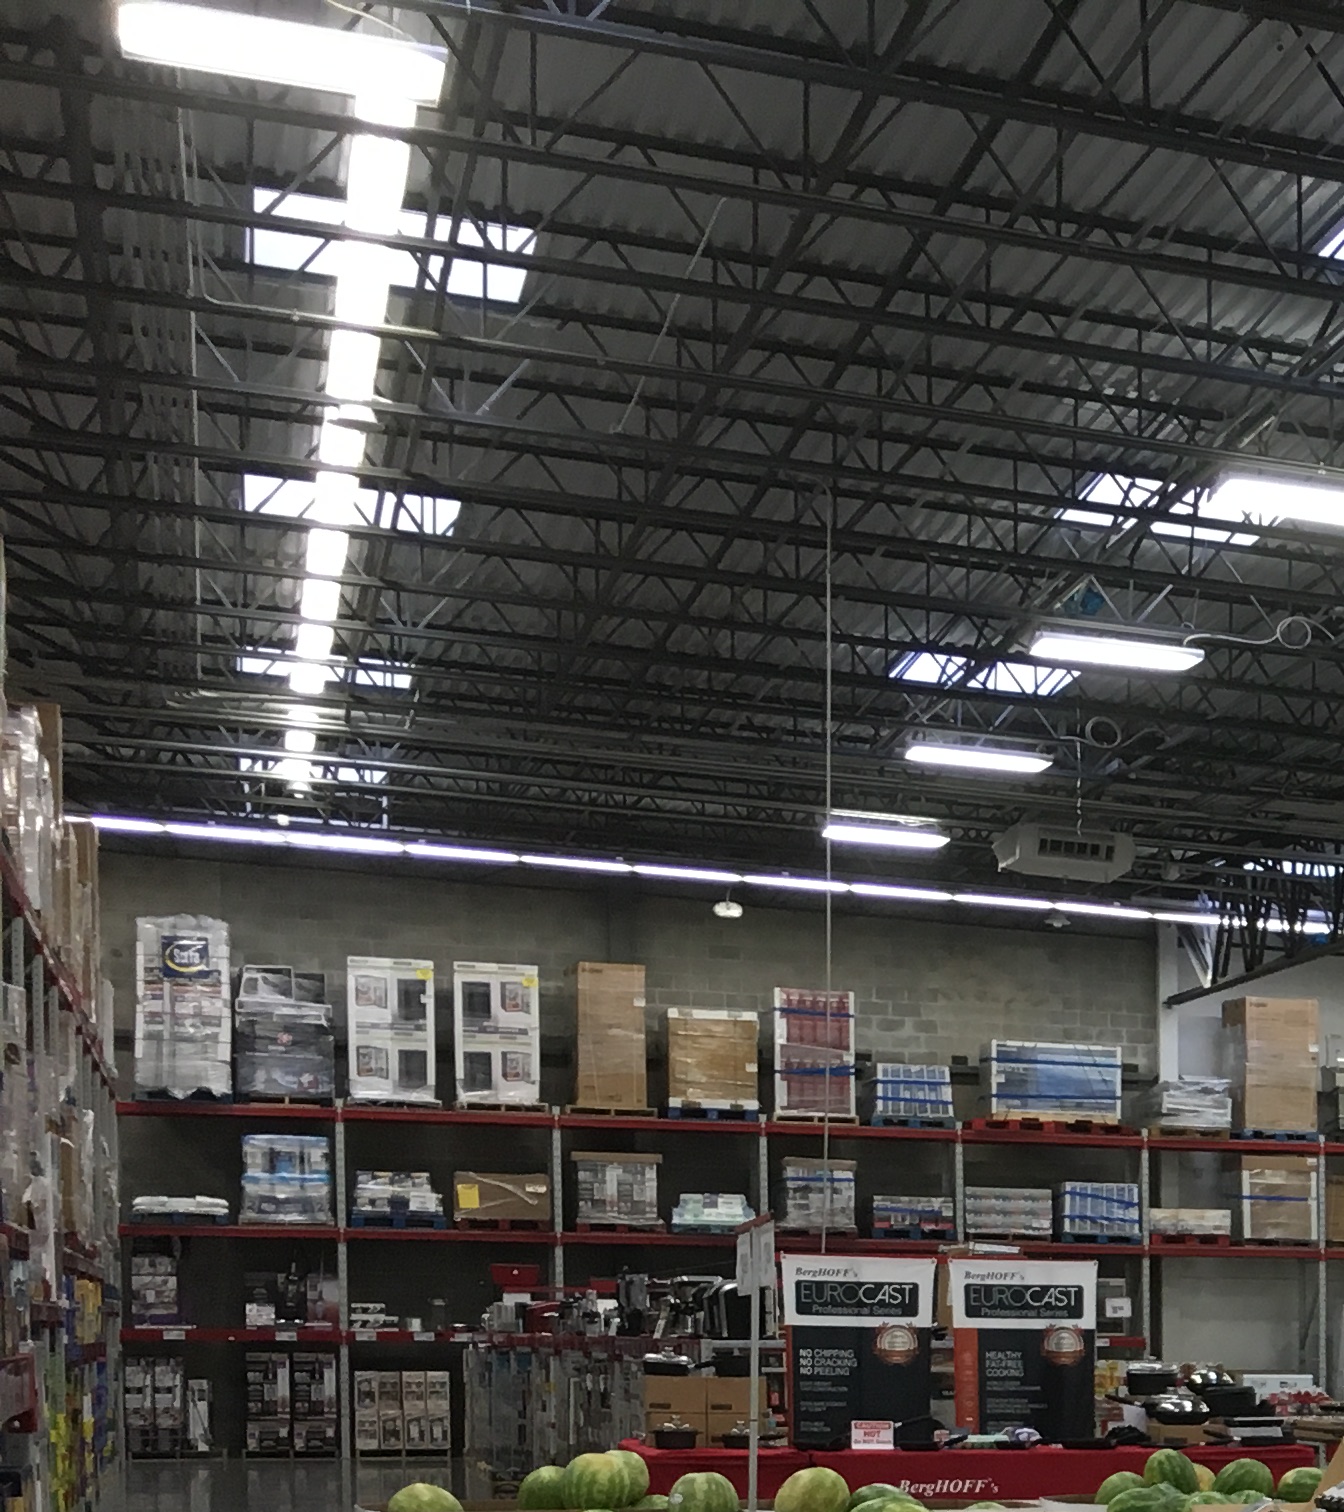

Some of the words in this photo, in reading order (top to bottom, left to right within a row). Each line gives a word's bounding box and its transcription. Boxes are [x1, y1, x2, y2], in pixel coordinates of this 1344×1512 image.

[801, 1283, 914, 1303] EUROCAST
[969, 1287, 1078, 1306] EUROCAST
[812, 1304, 870, 1315] Professional
[872, 1305, 902, 1316] Series
[981, 1307, 1038, 1317] Professional
[1040, 1308, 1068, 1318] Series
[800, 1349, 812, 1358] NO
[814, 1349, 854, 1358] CHIPPING
[985, 1351, 1021, 1360] HEALTHY
[800, 1358, 812, 1367] NO
[814, 1358, 858, 1367] CRACKING
[800, 1367, 812, 1376] NO
[814, 1367, 850, 1376] PEELING
[985, 1368, 1024, 1377] COOKING
